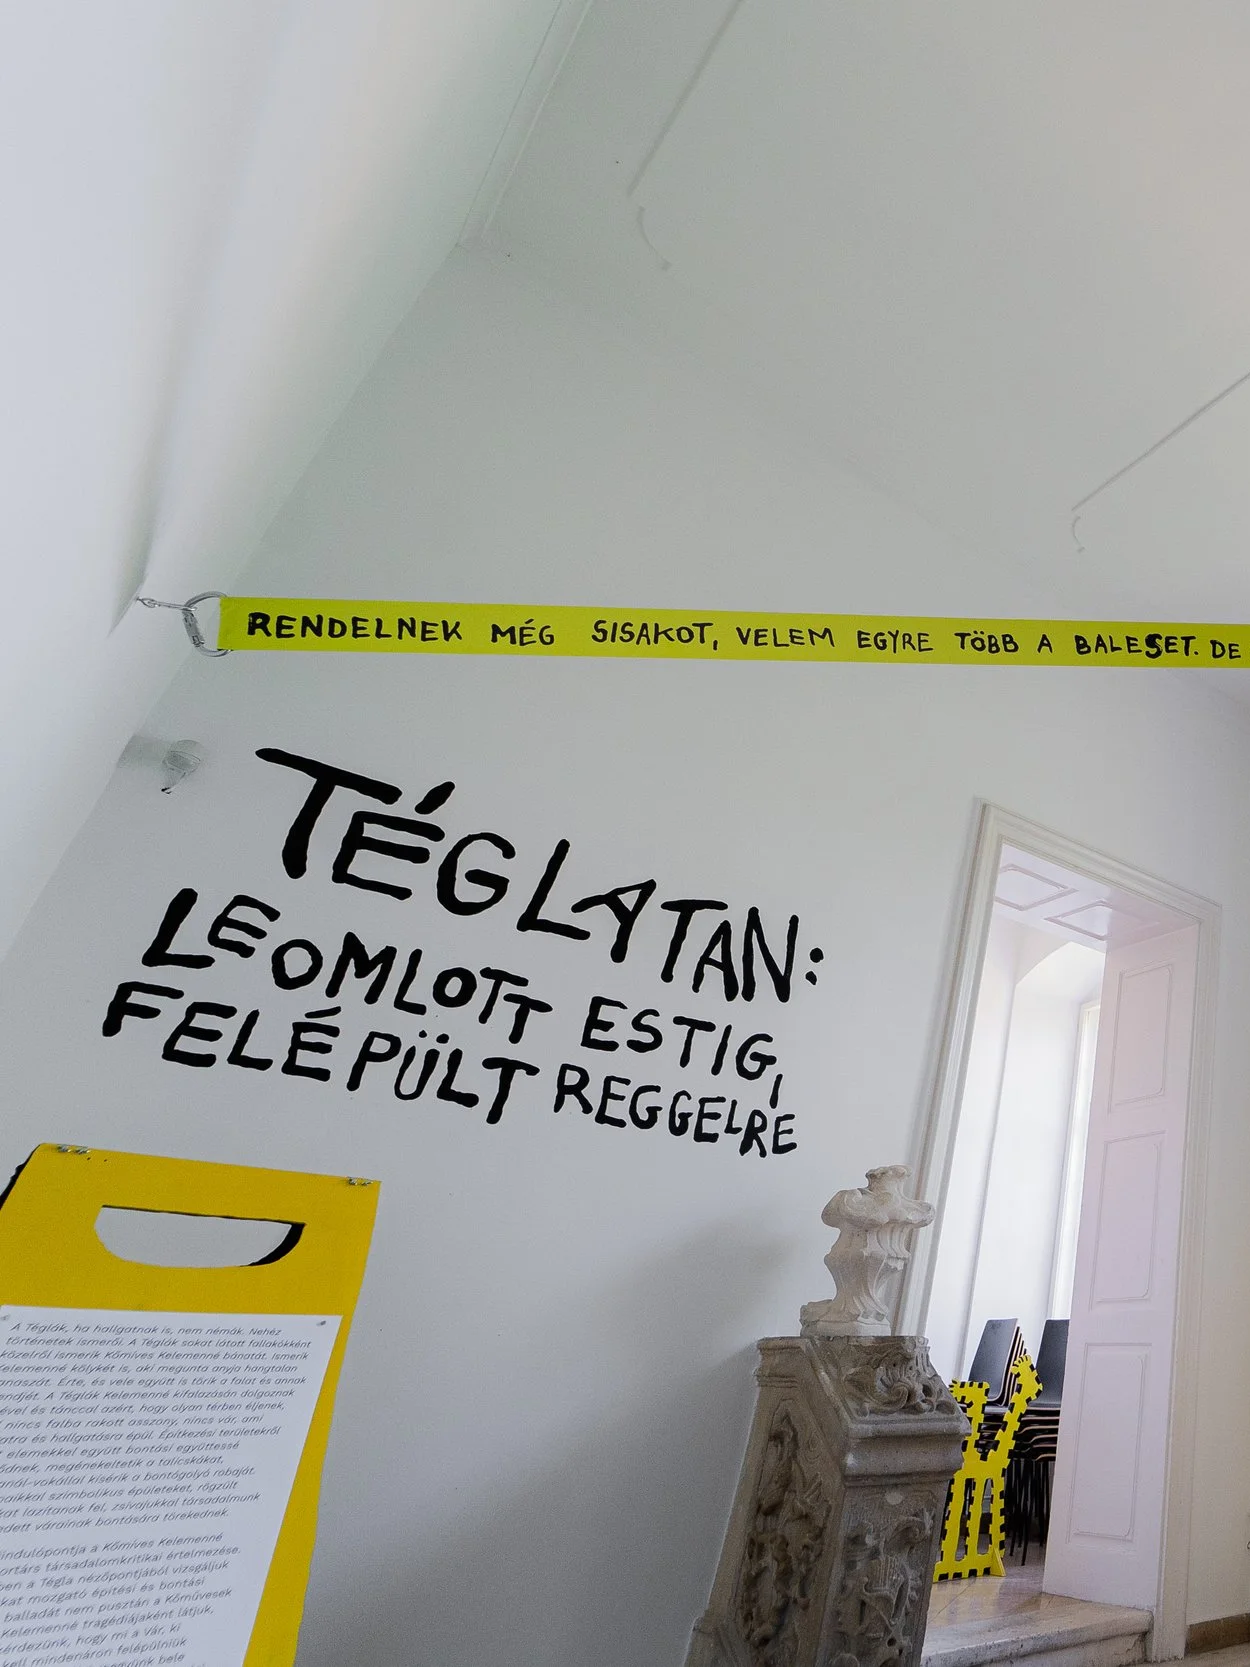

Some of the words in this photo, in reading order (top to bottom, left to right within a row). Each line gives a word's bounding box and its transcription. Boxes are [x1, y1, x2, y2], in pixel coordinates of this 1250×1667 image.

[246, 611, 463, 643] RENDELNEK
[490, 618, 555, 647] MÉG
[591, 619, 719, 651] SISAKOT,
[735, 626, 835, 648] VELEM
[856, 629, 934, 654] EGYRE
[953, 630, 1020, 655] TÖBB
[1036, 633, 1053, 654] A
[1074, 633, 1199, 660] BALESET.
[1209, 639, 1242, 660] DE
[256, 747, 824, 1003] TÉGLATAN:
[142, 888, 553, 1043] LEOMLOTT
[581, 996, 785, 1108] ESTIG,
[102, 981, 540, 1125] FELÉPÜLT
[554, 1064, 797, 1158] REGGELRE
[10, 1322, 21, 1332] A
[26, 1323, 69, 1334] Téglák,
[73, 1323, 90, 1333] ha
[93, 1324, 159, 1336] hallgatnak
[161, 1326, 174, 1335] is,
[205, 1327, 245, 1336] némák.
[249, 1327, 282, 1336] Nehéz
[5, 1336, 74, 1346] történetek
[75, 1337, 124, 1347] ismerői.
[127, 1338, 137, 1347] A
[141, 1338, 179, 1349] Téglák
[181, 1339, 213, 1347] sokat
[215, 1338, 245, 1348] látott
[53, 1350, 101, 1360] ismerik
[103, 1350, 154, 1360] Kőmíves
[157, 1351, 220, 1360] Kelemenné
[222, 1352, 267, 1360] bánatát.
[271, 1352, 310, 1361] Ismerik
[70, 1363, 115, 1375] kölykét
[118, 1364, 131, 1374] is,
[135, 1364, 155, 1373] aki
[156, 1365, 209, 1375] megunta
[211, 1365, 241, 1374] anyja
[243, 1364, 298, 1375] hangtalan
[57, 1375, 86, 1388] Érte,
[91, 1377, 106, 1386] és
[109, 1376, 134, 1386] vele
[137, 1376, 175, 1388] együtt
[178, 1377, 188, 1385] is
[191, 1376, 217, 1385] törik
[230, 1376, 257, 1385] falat
[259, 1376, 272, 1385] és
[274, 1376, 307, 1385] annak
[44, 1391, 54, 1401] A
[59, 1391, 100, 1402] Téglák
[103, 1390, 170, 1400] Kelemenné
[172, 1389, 238, 1399] kifalazásán
[240, 1389, 295, 1399] dolgoznak
[30, 1405, 46, 1415] és
[49, 1404, 100, 1414] tánccal
[101, 1404, 135, 1414] azért,
[139, 1403, 169, 1414] hogy
[171, 1402, 202, 1413] olyan
[205, 1402, 242, 1411] térben
[245, 1401, 285, 1412] éljenek,
[4, 1420, 41, 1430] nincs
[46, 1419, 82, 1429] falba
[84, 1418, 125, 1428] rakott
[128, 1417, 178, 1428] asszony,
[182, 1416, 215, 1425] nincs
[218, 1415, 237, 1425] vár,
[241, 1415, 264, 1424] ami
[32, 1434, 47, 1444] és
[50, 1431, 123, 1445] hallgatásra
[126, 1430, 154, 1442] épül.
[158, 1427, 216, 1441] Építkezési
[6, 1447, 78, 1459] elemekkel
[80, 1446, 122, 1458] együtt
[125, 1444, 174, 1455] bontási
[176, 1441, 240, 1454] együttessé
[146, 1459, 155, 1467] a
[88, 1472, 130, 1485] kísérik
[131, 1474, 141, 1482] a
[143, 1468, 211, 1482] bontógolyó
[213, 1466, 256, 1478] robaját.
[48, 1488, 125, 1501] szimbolikus
[127, 1483, 193, 1497] épületeket,
[196, 1480, 239, 1493] rögzült
[22, 1504, 85, 1517] lazítanak
[87, 1502, 107, 1513] fel,
[111, 1498, 179, 1511] zsivajukkal
[35, 1518, 93, 1531] várainak
[95, 1513, 160, 1527] bontására
[162, 1508, 229, 1522] törekednek.
